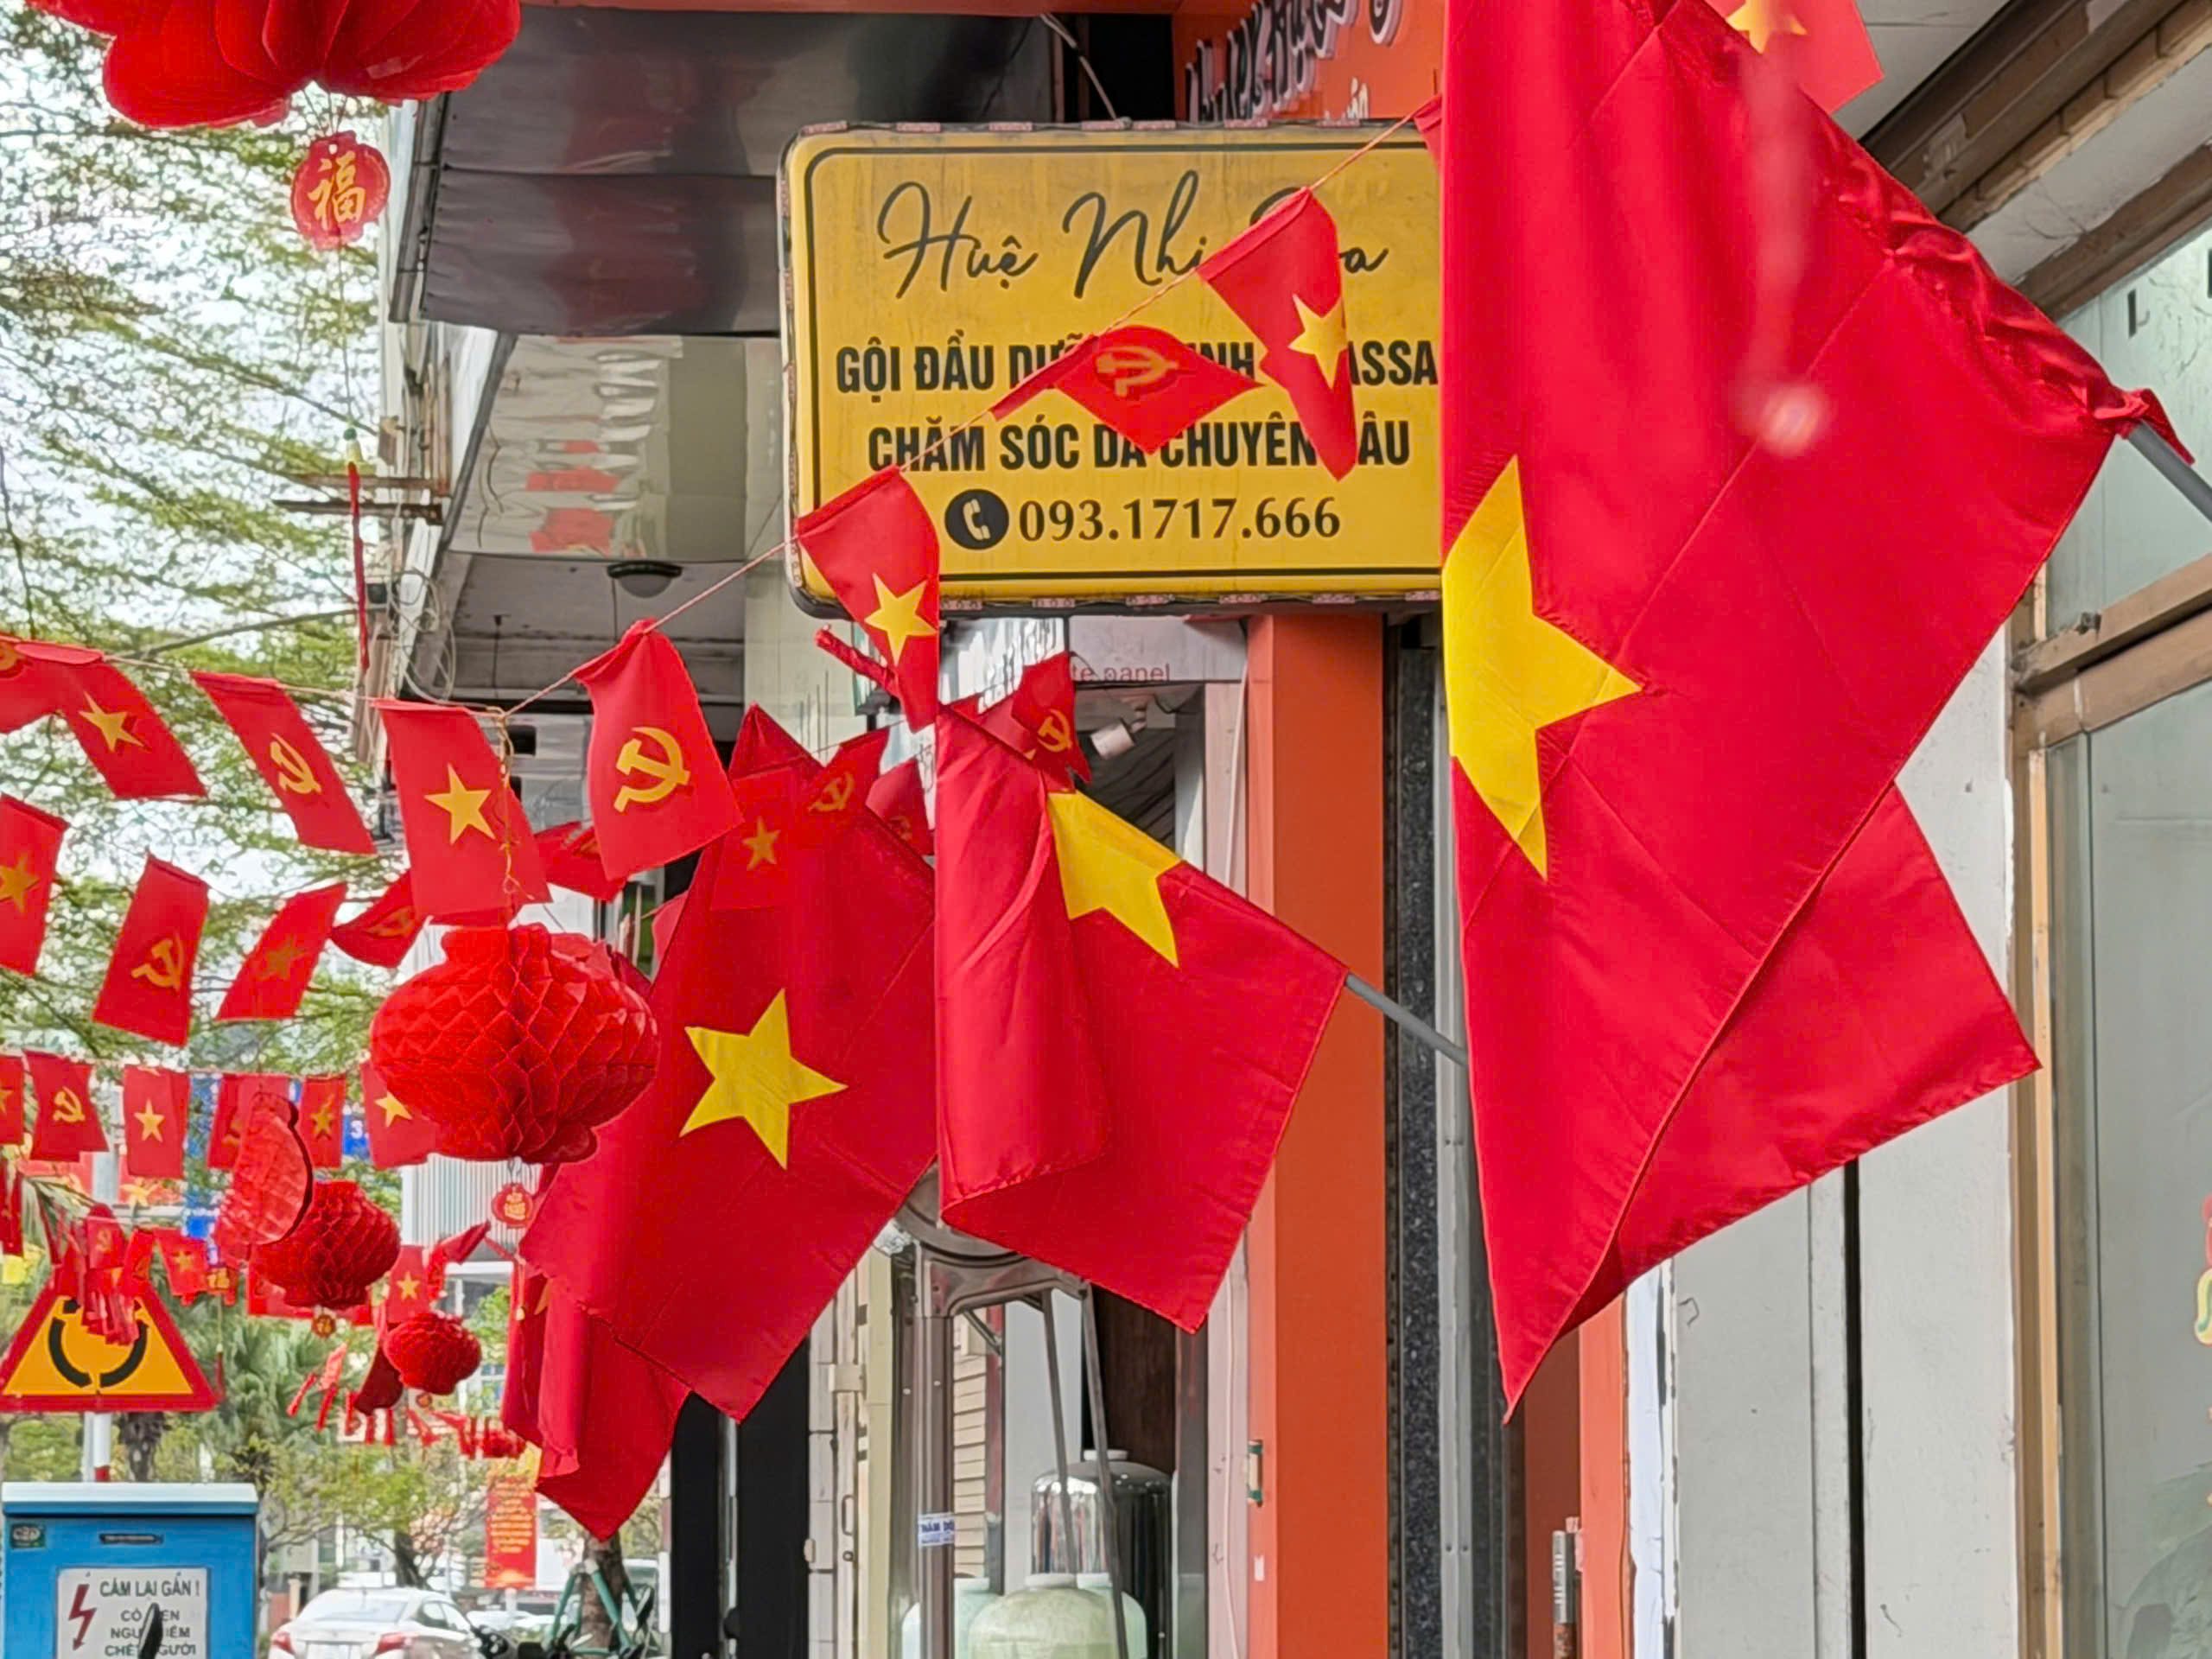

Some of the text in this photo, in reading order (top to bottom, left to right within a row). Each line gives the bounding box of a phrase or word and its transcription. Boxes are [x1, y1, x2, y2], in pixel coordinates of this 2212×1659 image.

[308, 150, 366, 232] 福
[876, 181, 1039, 299] Huệ
[1062, 169, 1207, 299] Nhi
[836, 336, 901, 403] GỘI
[913, 329, 995, 391] ĐẦU
[868, 416, 985, 472] CHĂM
[1000, 415, 1079, 470] SÓC
[1160, 411, 1318, 467] CHUYÊN
[1357, 411, 1410, 466] ÂU
[1020, 497, 1340, 542] 093.1717.666
[120, 1608, 143, 1622] CÓ
